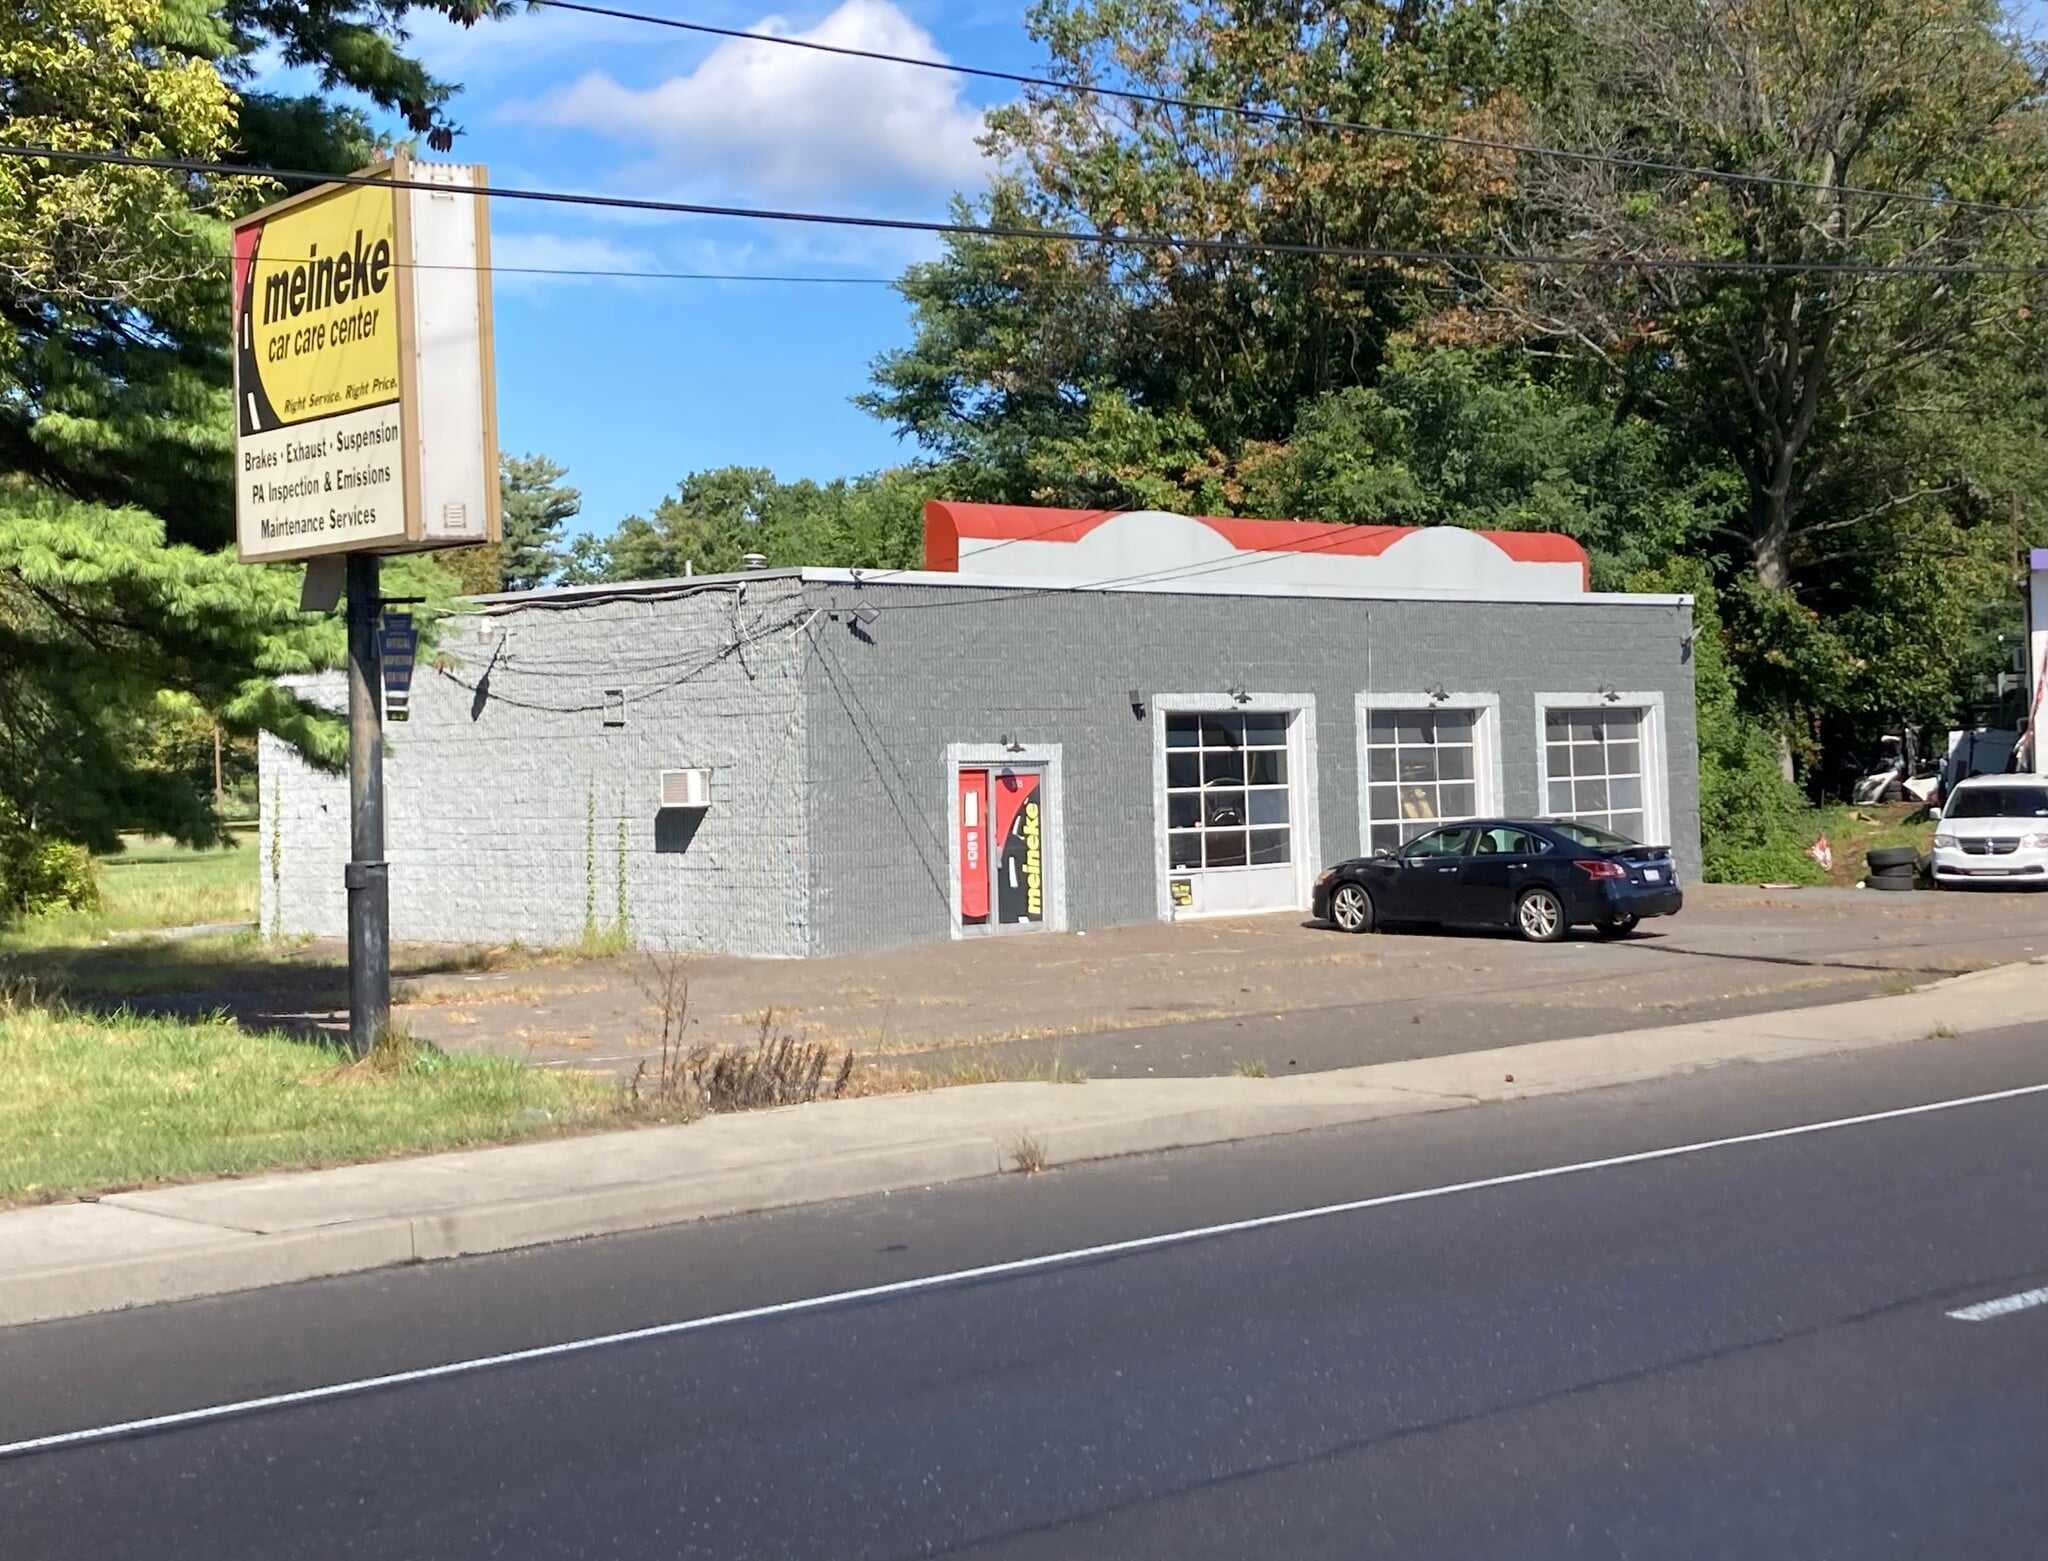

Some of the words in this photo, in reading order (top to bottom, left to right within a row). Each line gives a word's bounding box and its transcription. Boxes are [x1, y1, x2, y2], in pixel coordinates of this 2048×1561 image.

[263, 229, 390, 325] meineke
[268, 333, 291, 363] car
[294, 323, 326, 356] care
[330, 306, 380, 347] center
[284, 396, 306, 414] Right
[308, 391, 342, 408] Service.
[345, 384, 369, 400] Right
[372, 377, 398, 393] Price.
[245, 448, 278, 472] Brakes
[286, 437, 326, 463] Exhaust
[336, 421, 398, 453] Suspension
[252, 484, 265, 504] PA
[268, 476, 319, 504] Inspection
[324, 471, 332, 492] &
[337, 464, 391, 490] Emissions
[261, 515, 325, 540] Maintenance
[329, 505, 376, 530] Services
[1022, 802, 1041, 915] meineke
